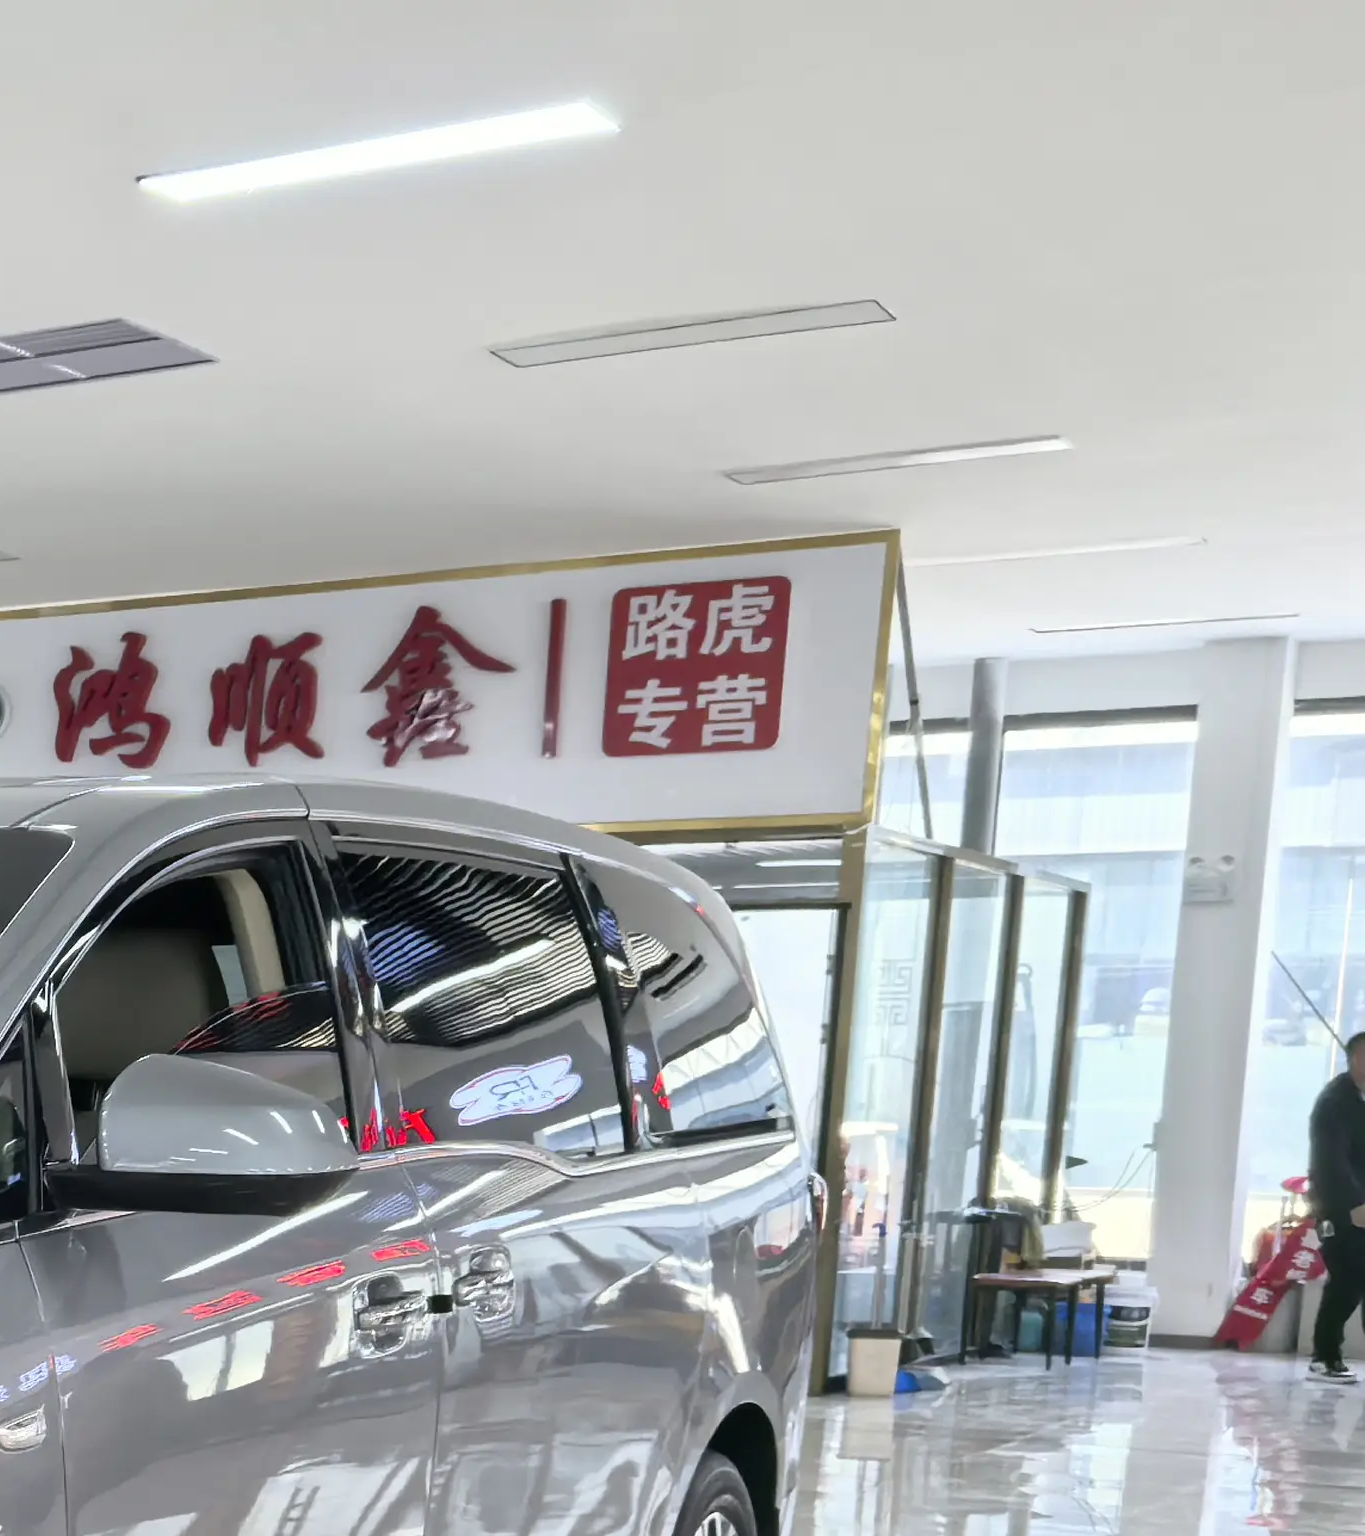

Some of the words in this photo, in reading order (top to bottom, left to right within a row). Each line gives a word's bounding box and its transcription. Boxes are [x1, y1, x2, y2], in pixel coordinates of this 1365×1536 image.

[622, 583, 775, 661] 路虎
[53, 604, 517, 769] 鸿顺鑫
[617, 673, 767, 749] 专营
